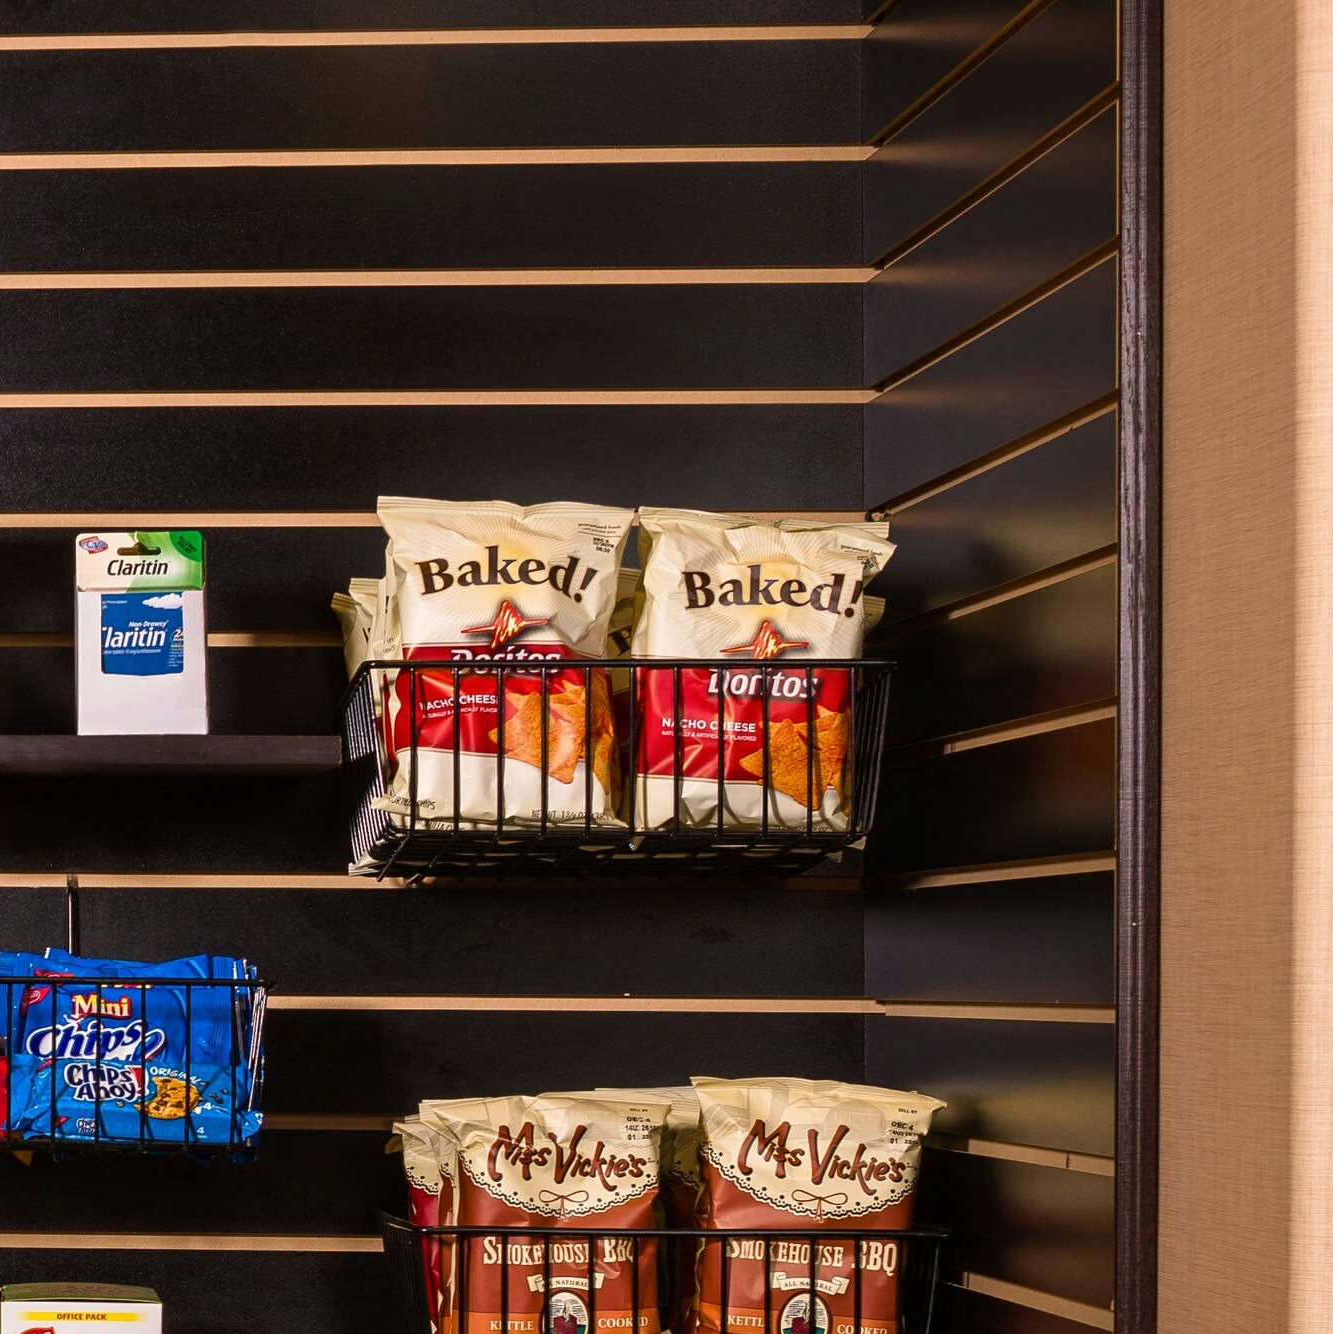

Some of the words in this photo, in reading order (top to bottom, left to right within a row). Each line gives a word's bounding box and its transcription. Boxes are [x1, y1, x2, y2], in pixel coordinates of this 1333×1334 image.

[107, 560, 168, 576] Claritin
[416, 545, 597, 603] Baked!
[682, 565, 863, 618] Baked!
[73, 994, 130, 1016] Mini
[548, 1124, 647, 1190] Vickie's
[808, 1125, 905, 1195] Vickie's
